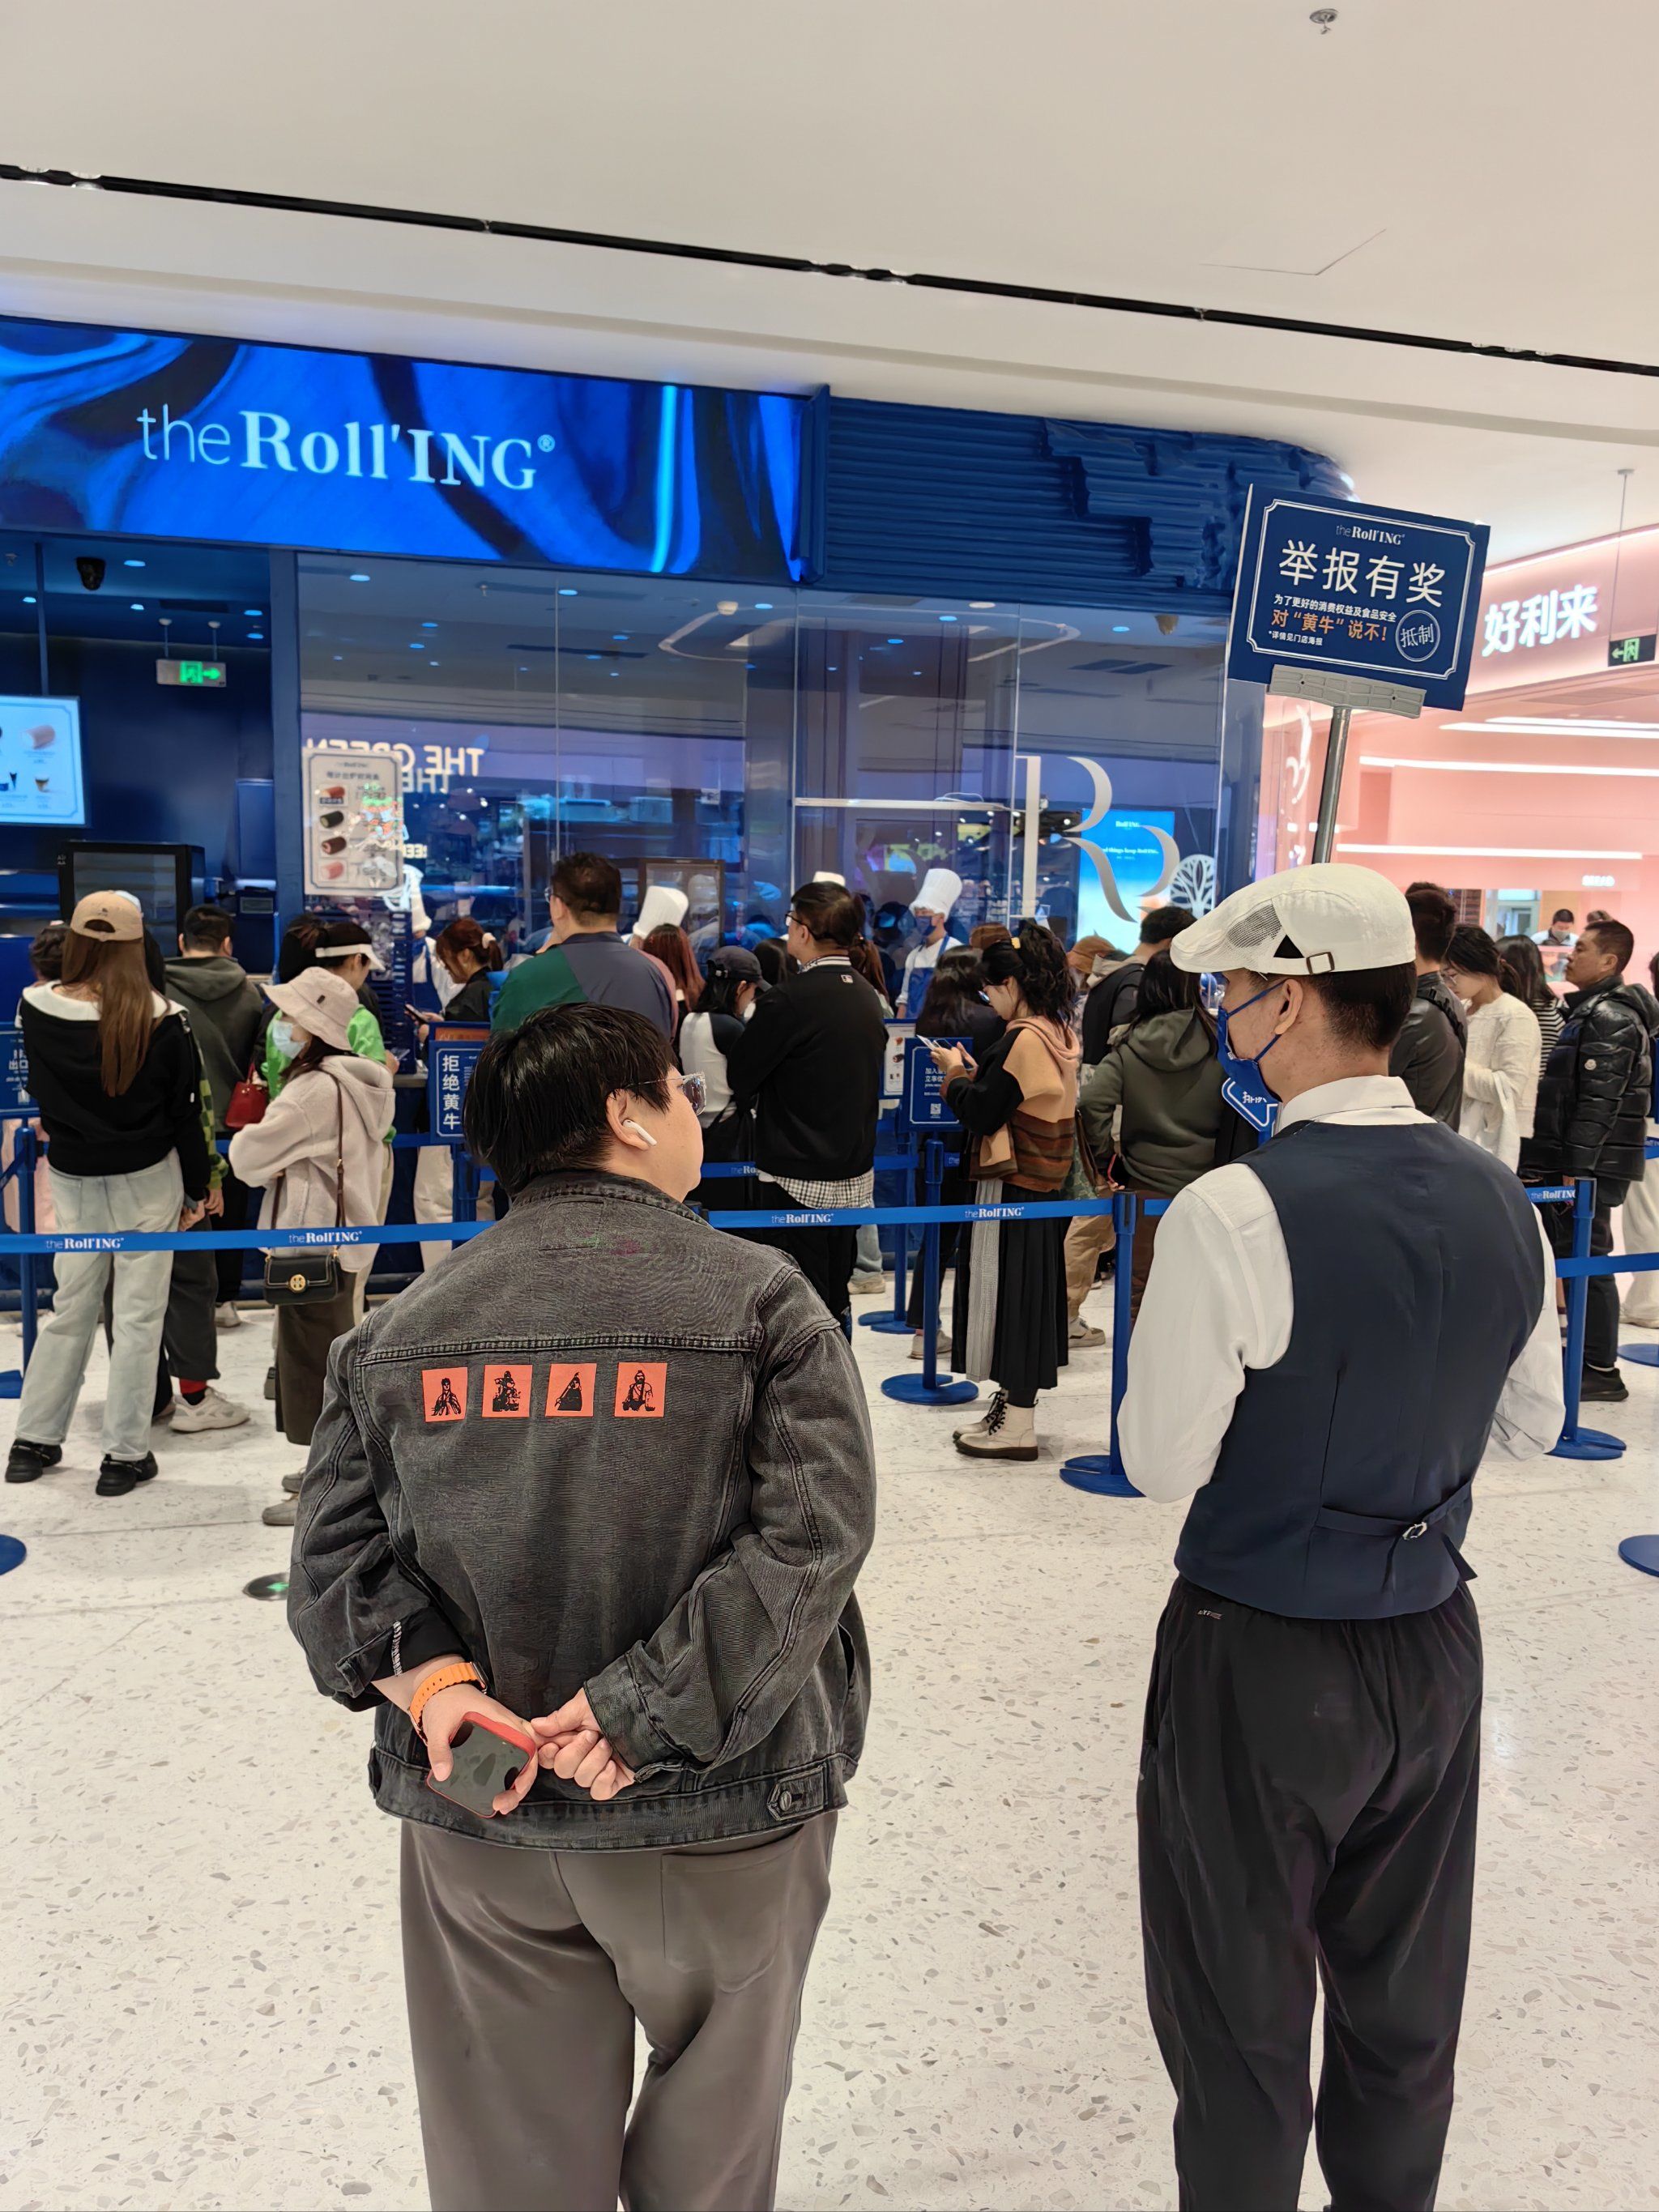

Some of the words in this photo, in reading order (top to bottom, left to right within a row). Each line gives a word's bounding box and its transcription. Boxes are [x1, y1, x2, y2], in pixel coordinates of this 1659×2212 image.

[1279, 539, 1446, 607] 举报有奖
[1400, 623, 1435, 648] 抵制
[1481, 583, 1598, 657] 好利来
[442, 1055, 461, 1131] 拒绝黄牛
